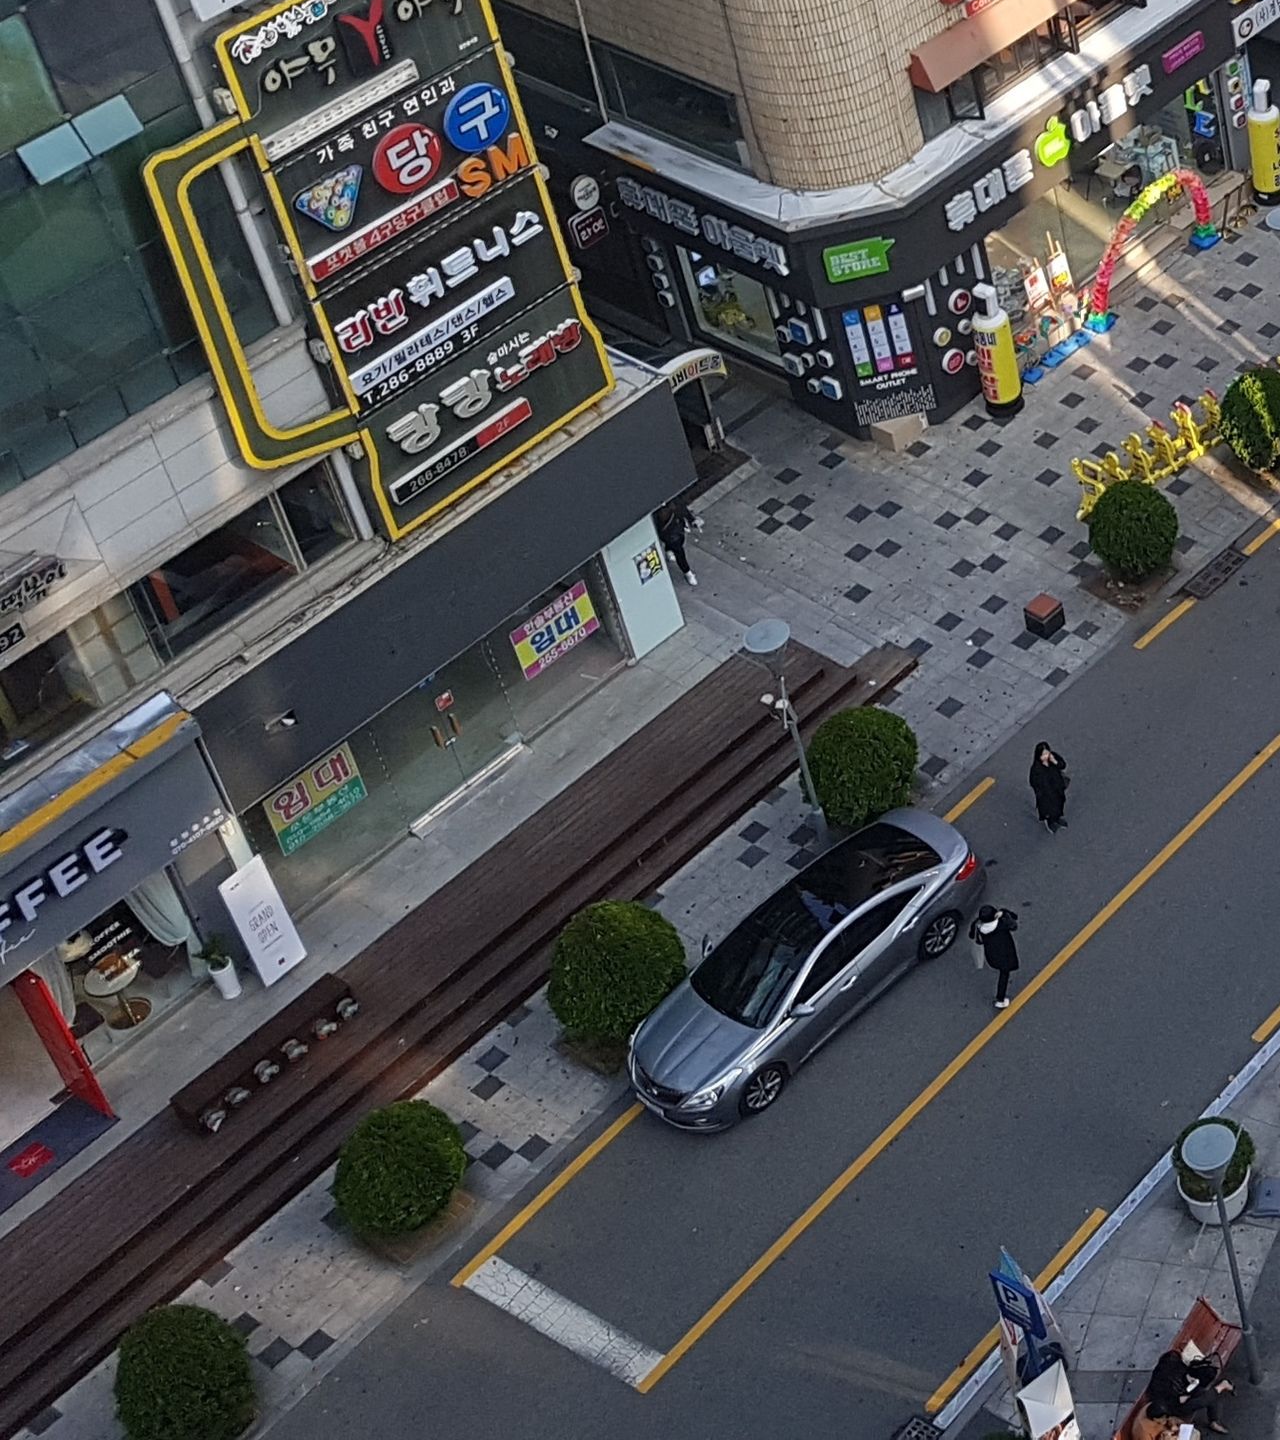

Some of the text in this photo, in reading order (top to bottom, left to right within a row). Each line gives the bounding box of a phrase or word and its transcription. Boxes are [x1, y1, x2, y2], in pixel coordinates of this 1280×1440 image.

[316, 75, 457, 165] 가족 친구 연인과
[456, 132, 530, 199] SM
[942, 148, 1035, 233] 휴대폰
[406, 210, 544, 309] 휘트니스
[828, 247, 869, 267] BEST
[830, 256, 882, 278] STORE
[362, 323, 480, 407] T.286-8889 3F
[485, 330, 531, 366] 술마시는
[859, 367, 919, 389] SMART PHONE
[875, 376, 907, 392] OUTLET
[529, 605, 582, 655] 임대
[271, 750, 351, 821] 임대
[257, 920, 280, 945] OPEN
[1003, 1285, 1019, 1305] P
